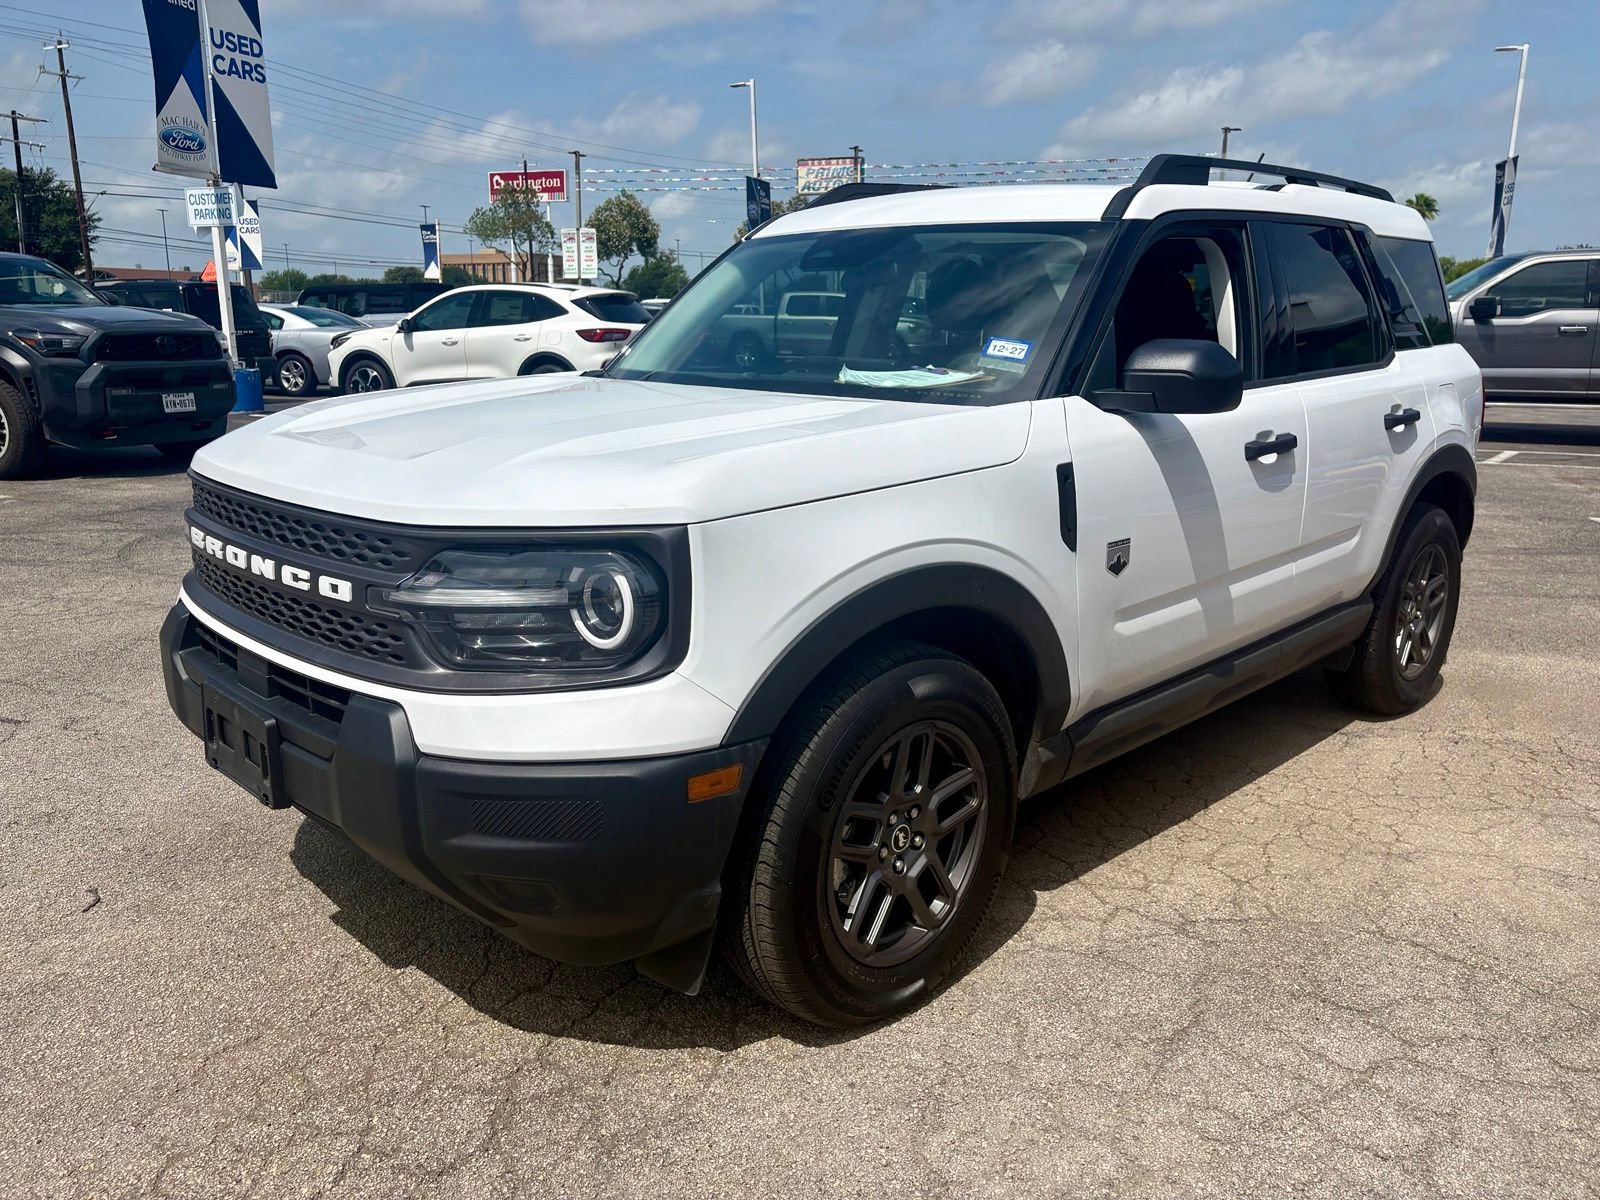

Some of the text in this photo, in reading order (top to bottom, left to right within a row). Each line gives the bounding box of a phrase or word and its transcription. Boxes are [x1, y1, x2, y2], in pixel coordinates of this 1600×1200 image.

[209, 27, 264, 59] USED
[212, 54, 267, 84] CARS
[161, 115, 181, 127] MAC
[169, 129, 200, 151] Ford
[188, 193, 233, 205] CUSTOMER
[194, 207, 231, 219] PARKING
[239, 218, 259, 226] USED
[992, 344, 1025, 355] 12 27
[190, 526, 353, 602] BRONCO
